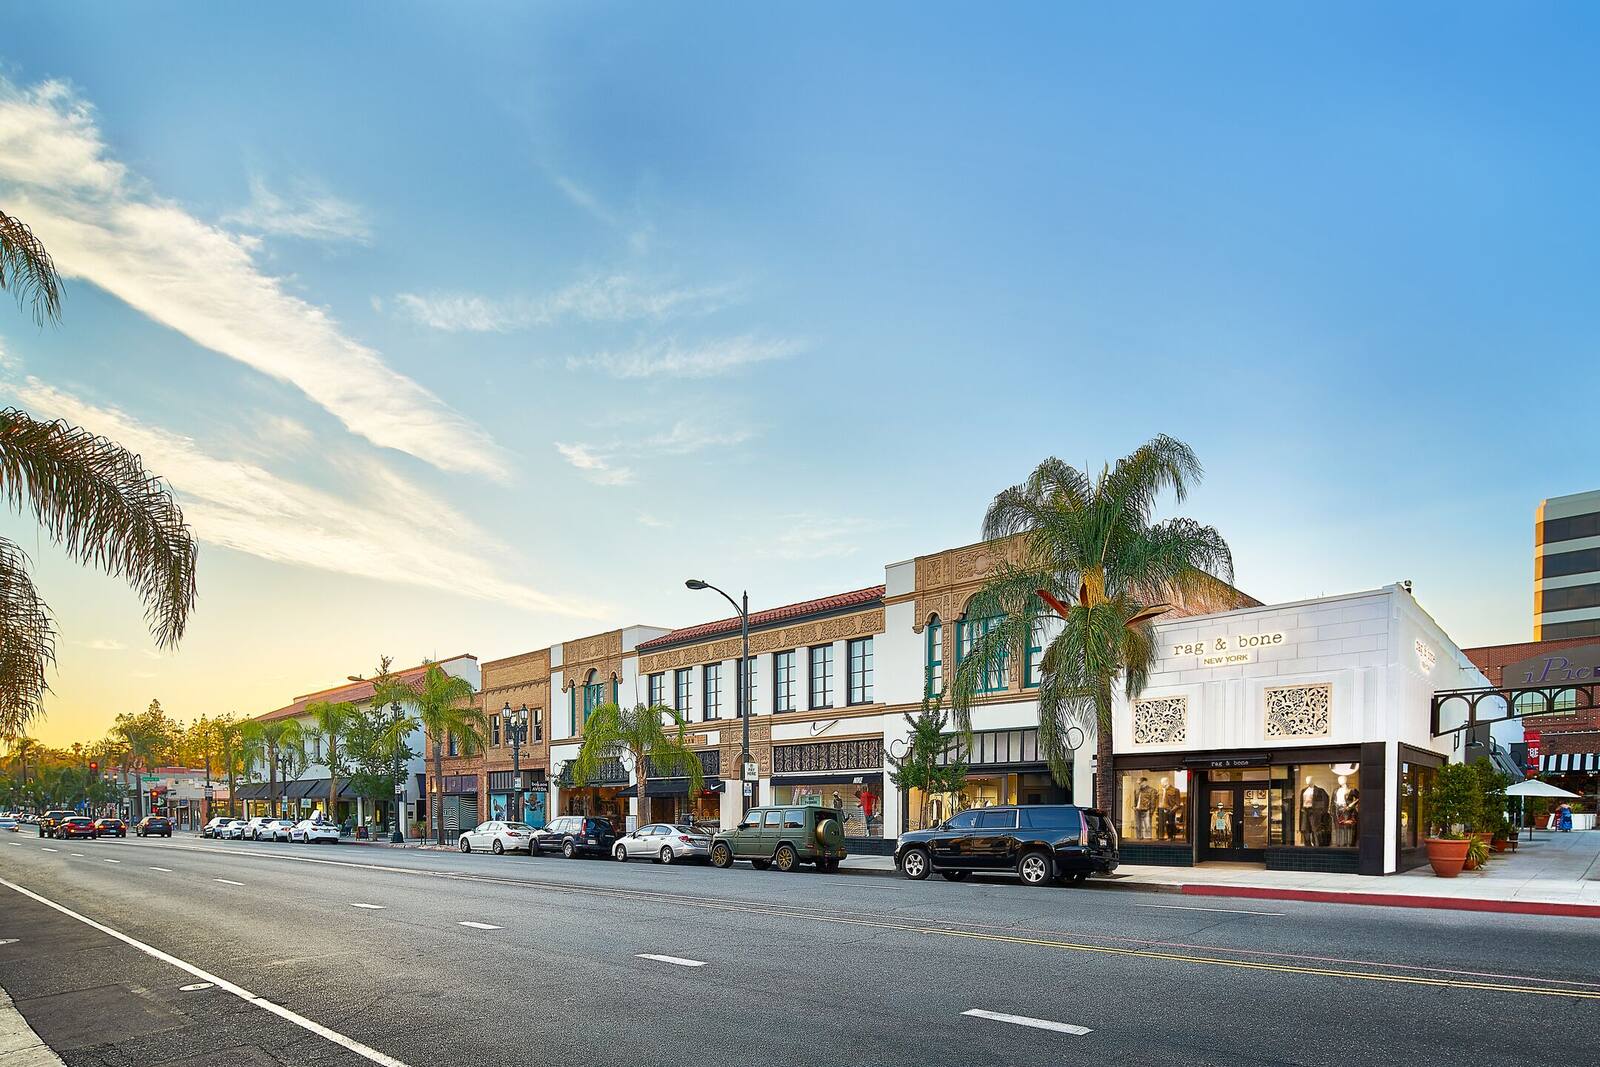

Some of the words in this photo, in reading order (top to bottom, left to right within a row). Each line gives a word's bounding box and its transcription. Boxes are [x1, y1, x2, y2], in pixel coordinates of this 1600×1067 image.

[1174, 642, 1204, 656] rag
[1215, 638, 1227, 651] &
[1238, 633, 1283, 648] bone
[1203, 656, 1224, 665] NEW
[1225, 654, 1248, 663] YORK
